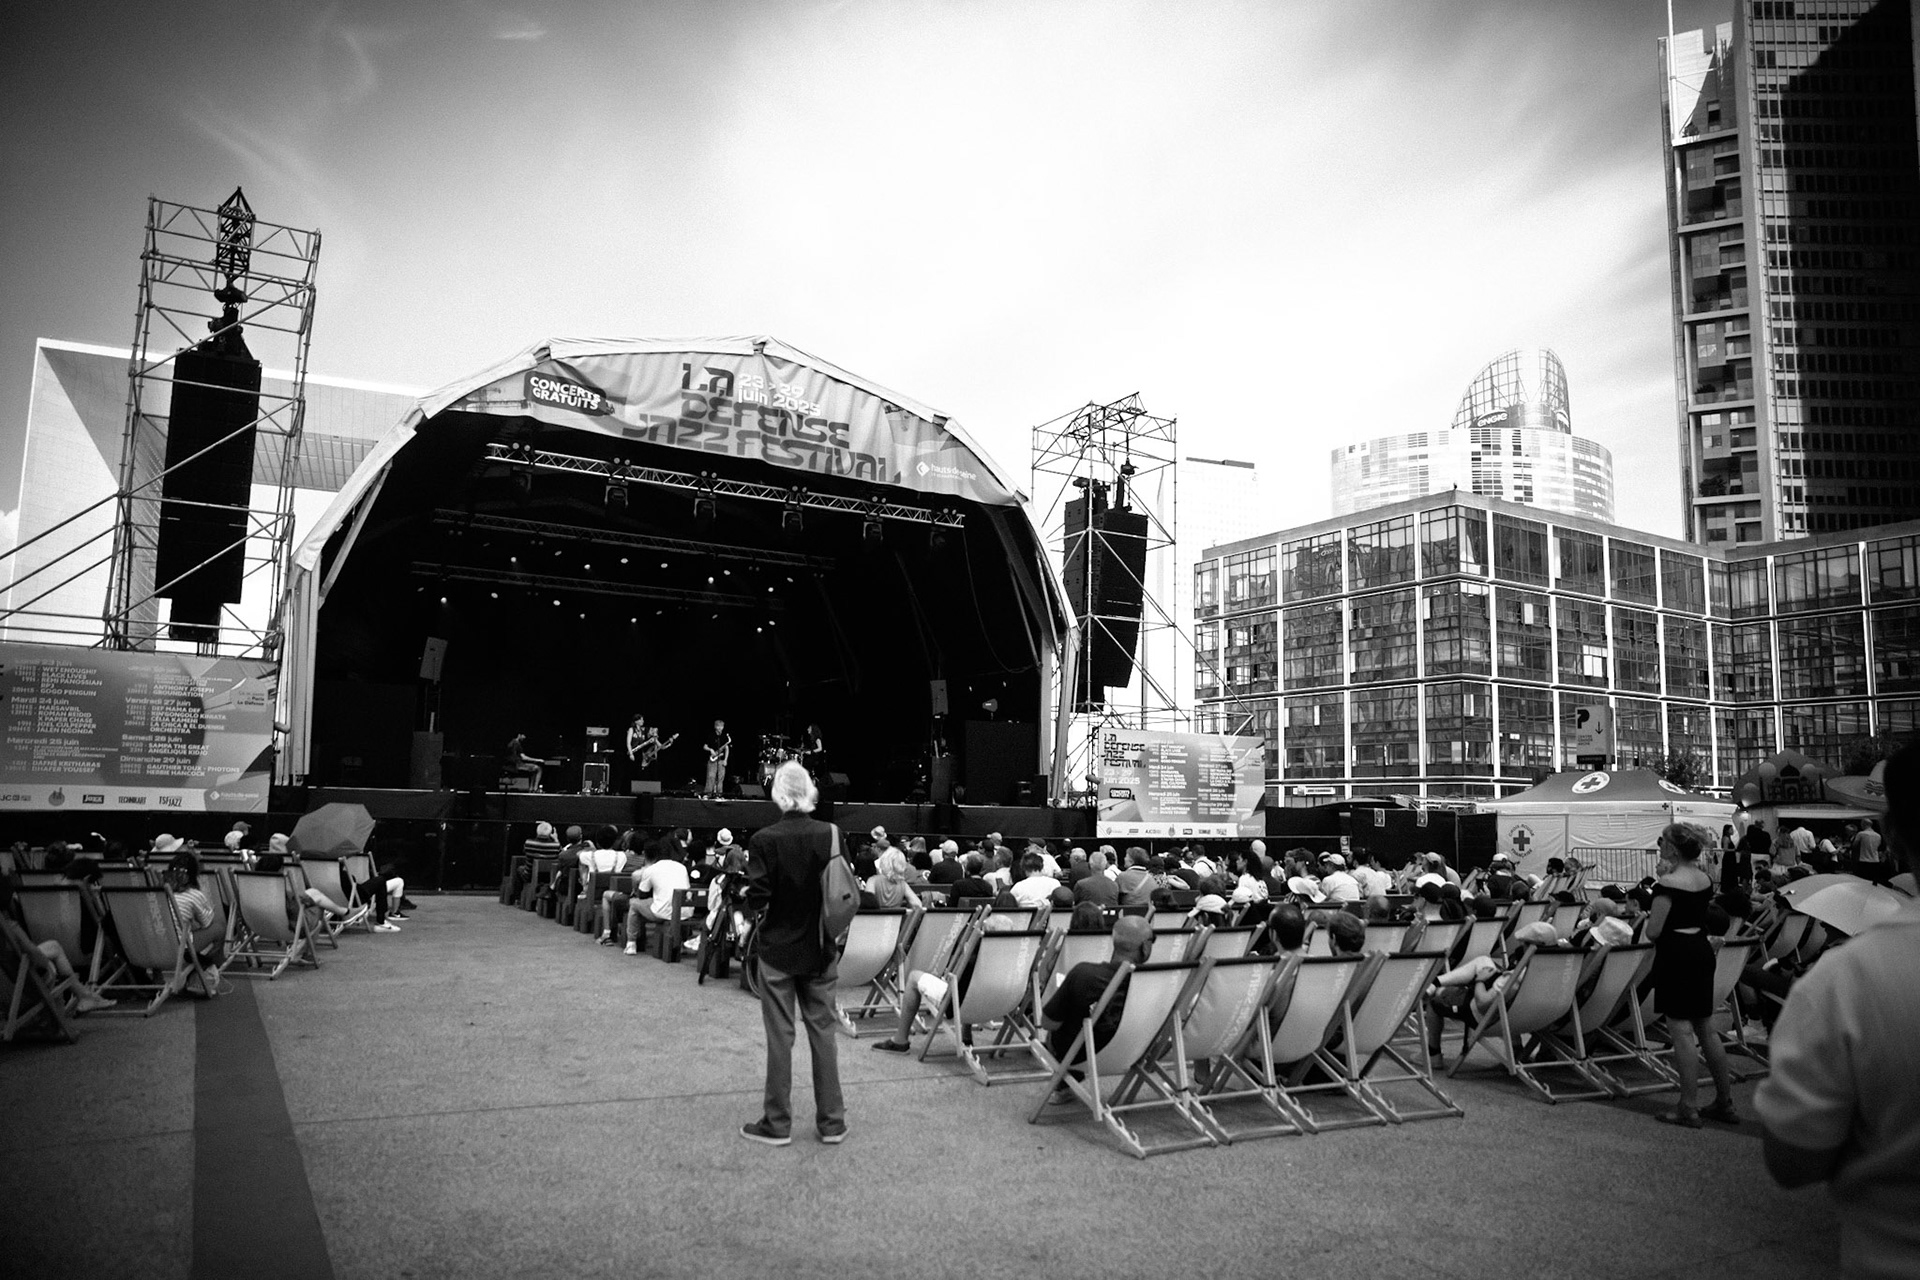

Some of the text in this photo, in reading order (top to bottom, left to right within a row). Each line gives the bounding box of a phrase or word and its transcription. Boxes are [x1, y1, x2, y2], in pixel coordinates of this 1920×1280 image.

[530, 376, 601, 403] CONCERTS
[682, 363, 734, 397] LA
[738, 373, 764, 389] 23
[780, 383, 804, 399] 29
[532, 387, 599, 410] GRATUITS
[738, 386, 821, 416] juin 2025
[622, 413, 729, 453] JAZZ
[736, 429, 901, 484] FESTIVAL
[64, 689, 97, 697] PENGUIN
[1577, 709, 1590, 729] P
[120, 755, 161, 763] Dimanche
[176, 757, 191, 765] juin
[1118, 777, 1141, 785] 2025
